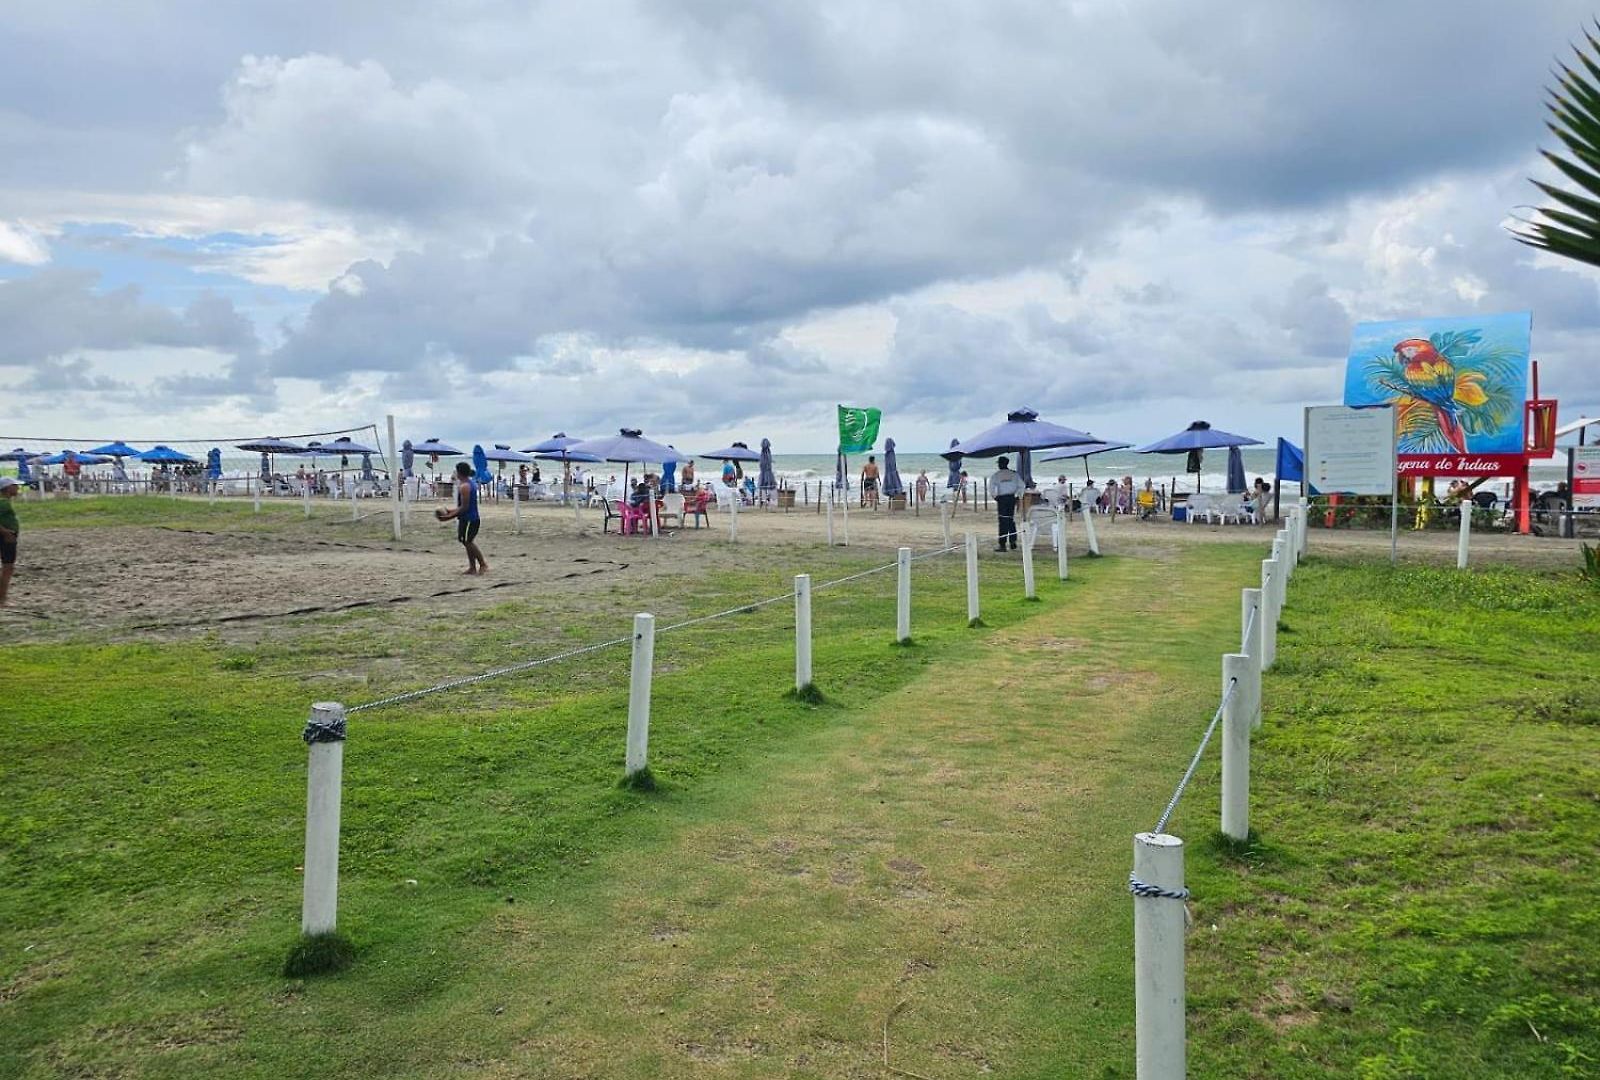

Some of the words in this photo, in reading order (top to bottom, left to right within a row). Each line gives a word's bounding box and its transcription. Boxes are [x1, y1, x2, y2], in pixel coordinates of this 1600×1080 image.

[1397, 460, 1430, 473] gena
[1435, 457, 1452, 470] de
[1457, 457, 1501, 470] Indias
